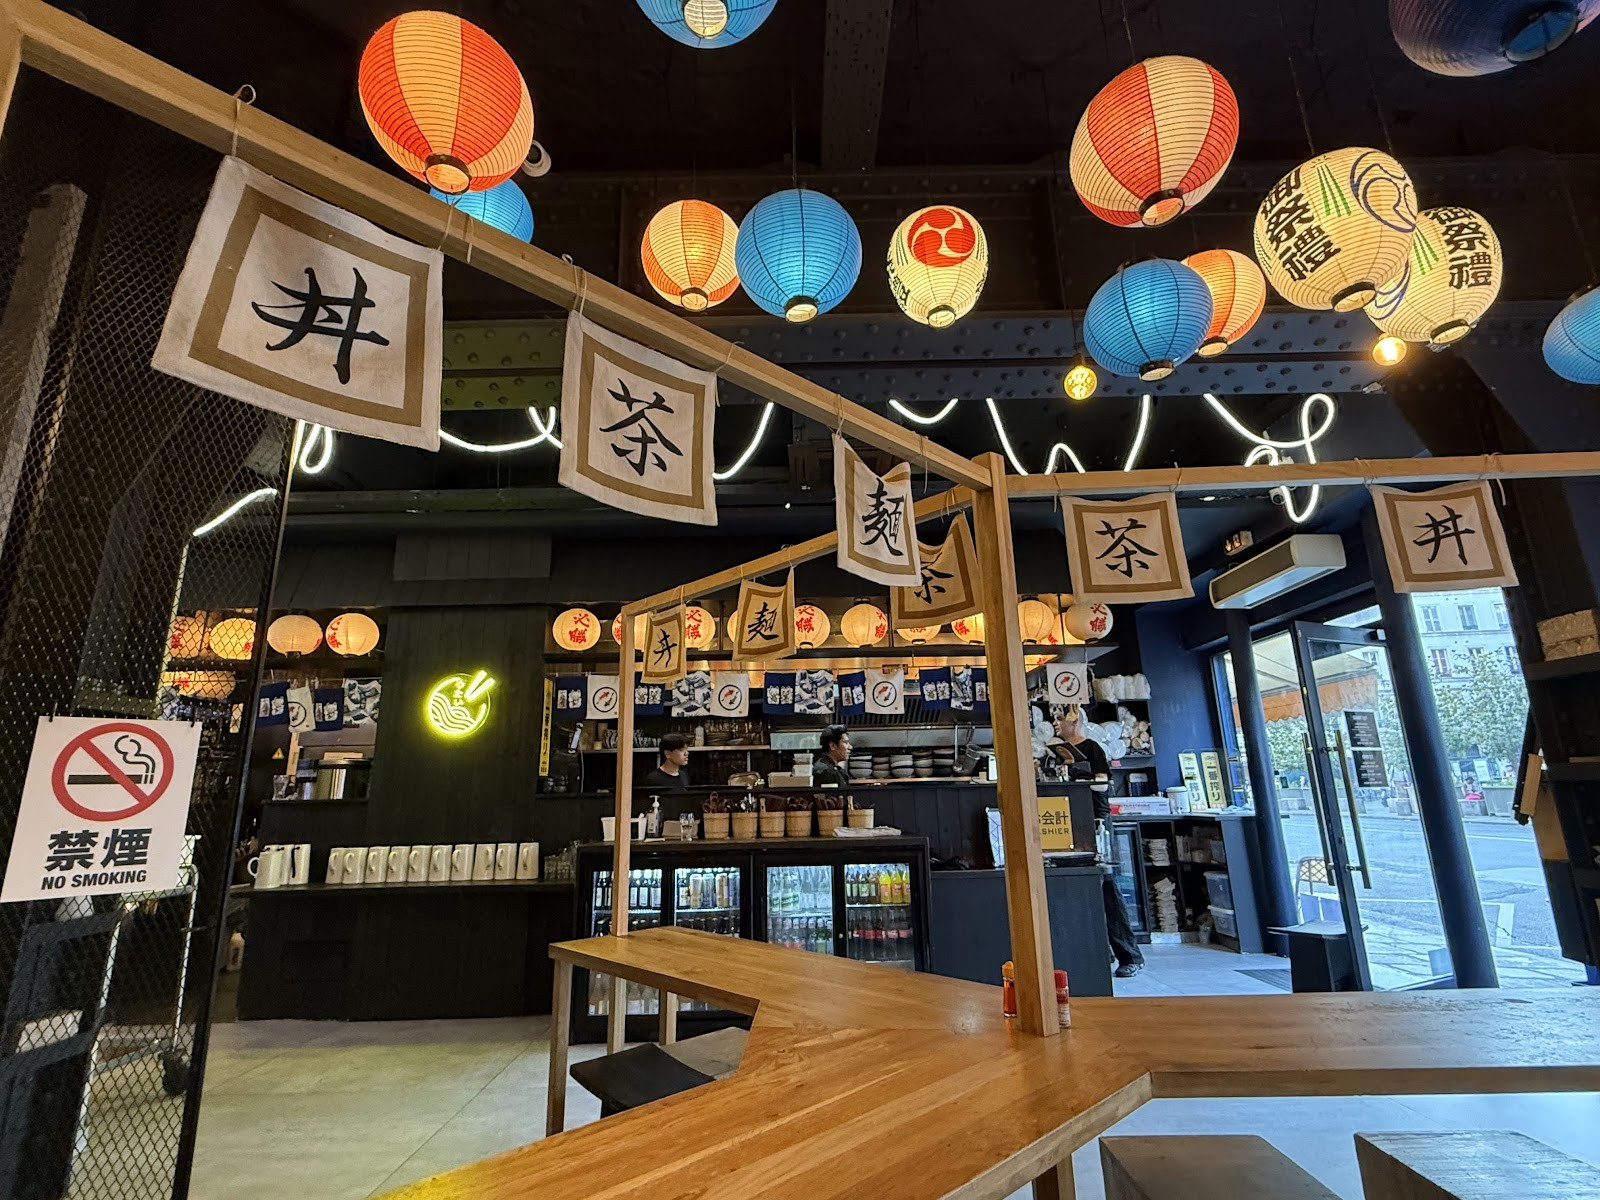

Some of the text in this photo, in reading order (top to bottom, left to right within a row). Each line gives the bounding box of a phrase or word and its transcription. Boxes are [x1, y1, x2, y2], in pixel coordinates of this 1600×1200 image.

[251, 266, 389, 385] 丼
[600, 376, 683, 477] 茶
[1095, 518, 1159, 578] 茶
[1413, 504, 1475, 566] 丼
[1038, 811, 1069, 826] 会計
[1040, 827, 1070, 835] SHIER
[45, 828, 152, 872] 禁煙
[41, 869, 147, 890] NO SMOKING
